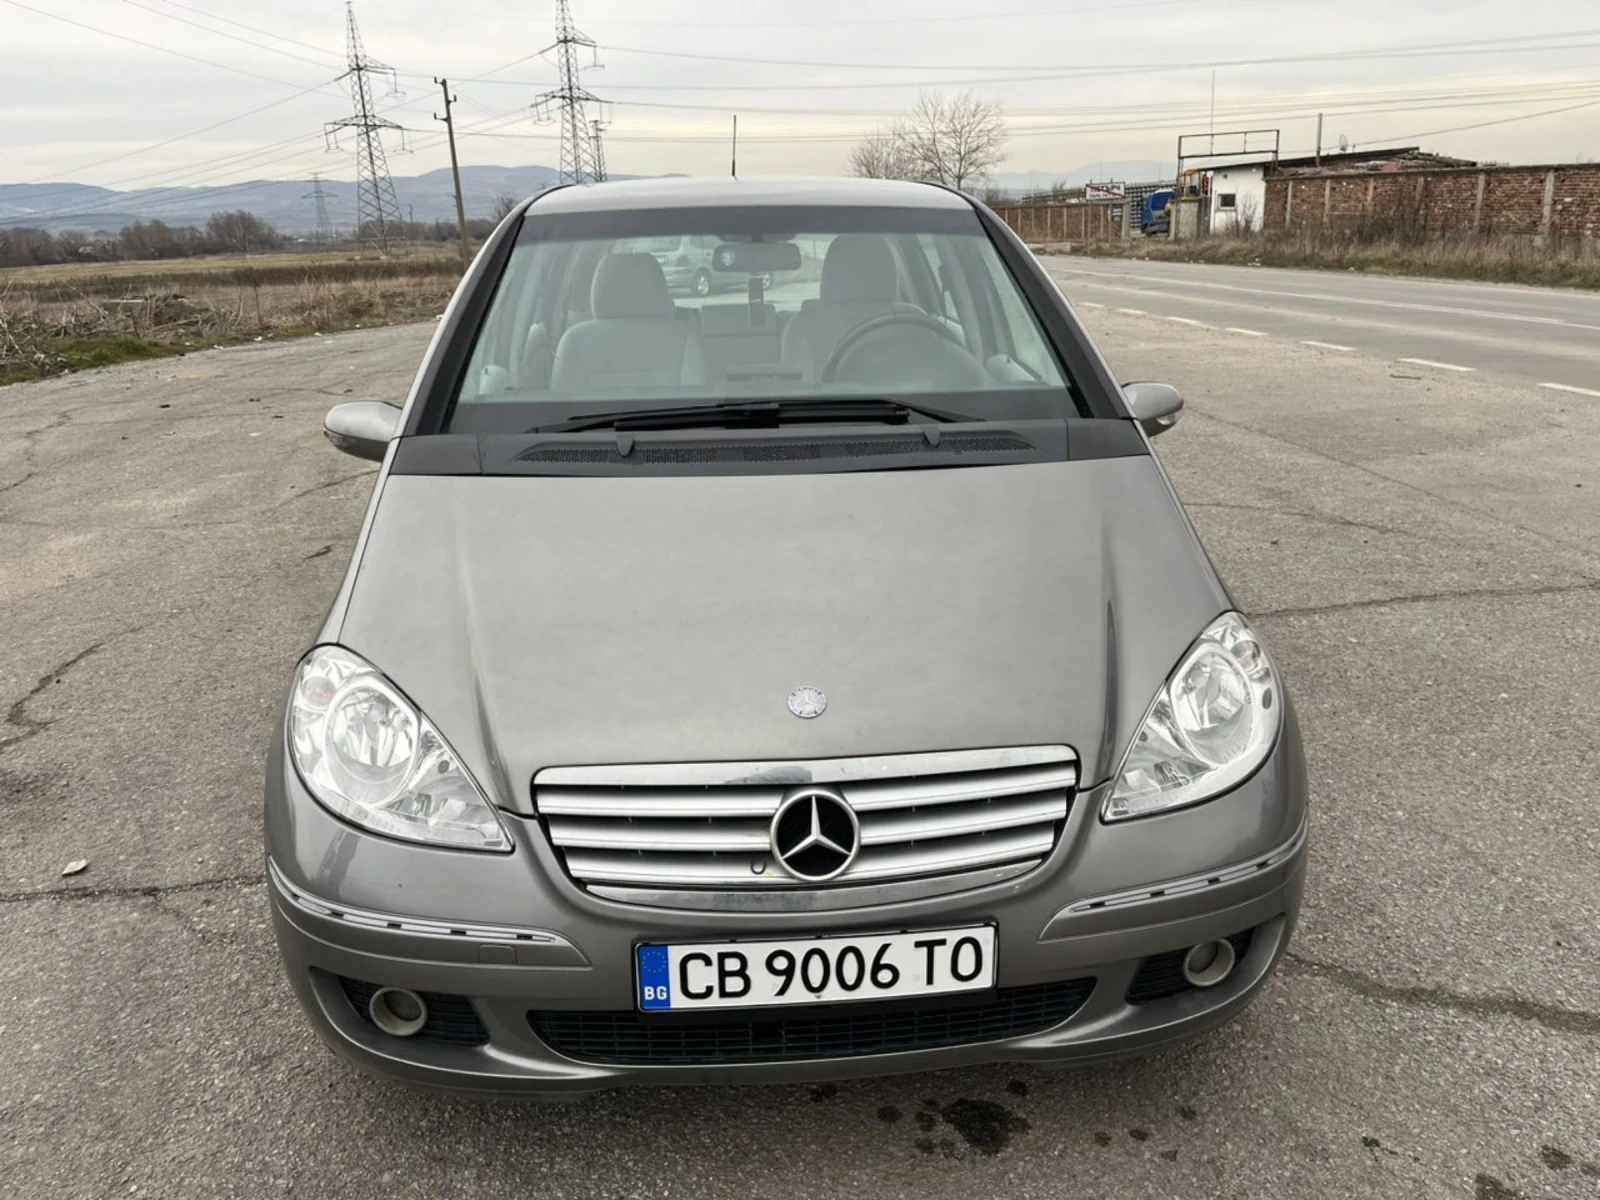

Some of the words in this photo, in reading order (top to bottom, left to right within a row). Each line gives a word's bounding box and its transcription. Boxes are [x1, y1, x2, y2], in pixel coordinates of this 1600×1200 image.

[679, 951, 752, 1000] CB
[765, 943, 900, 997] 9006
[914, 936, 983, 986] TO
[644, 986, 668, 1000] BG
